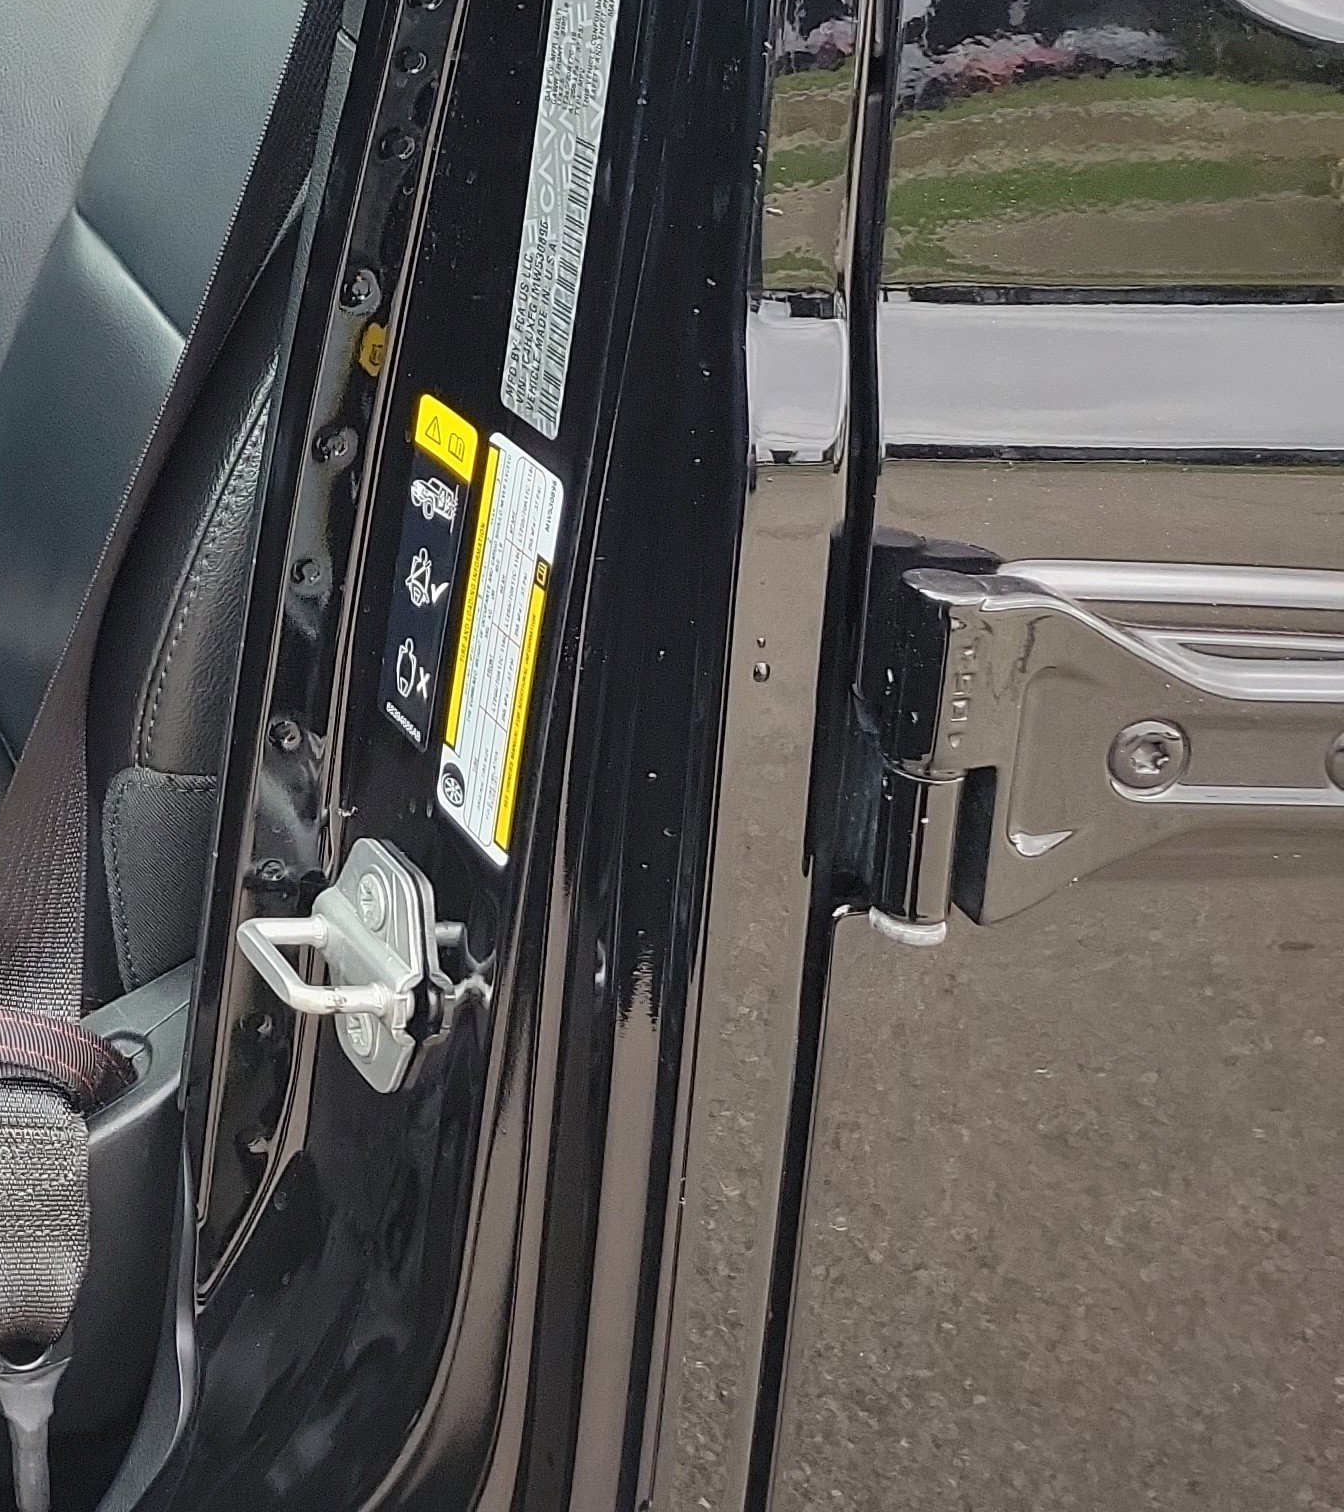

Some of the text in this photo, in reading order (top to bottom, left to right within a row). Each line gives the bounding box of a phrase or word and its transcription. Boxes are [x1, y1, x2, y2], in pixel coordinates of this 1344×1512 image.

[539, 282, 551, 306] IN:
[505, 250, 533, 399] MFD BY: FCA US LLC
[533, 306, 548, 352] MADE
[515, 375, 527, 407] VIN:
[525, 351, 541, 414] VEHICLE
